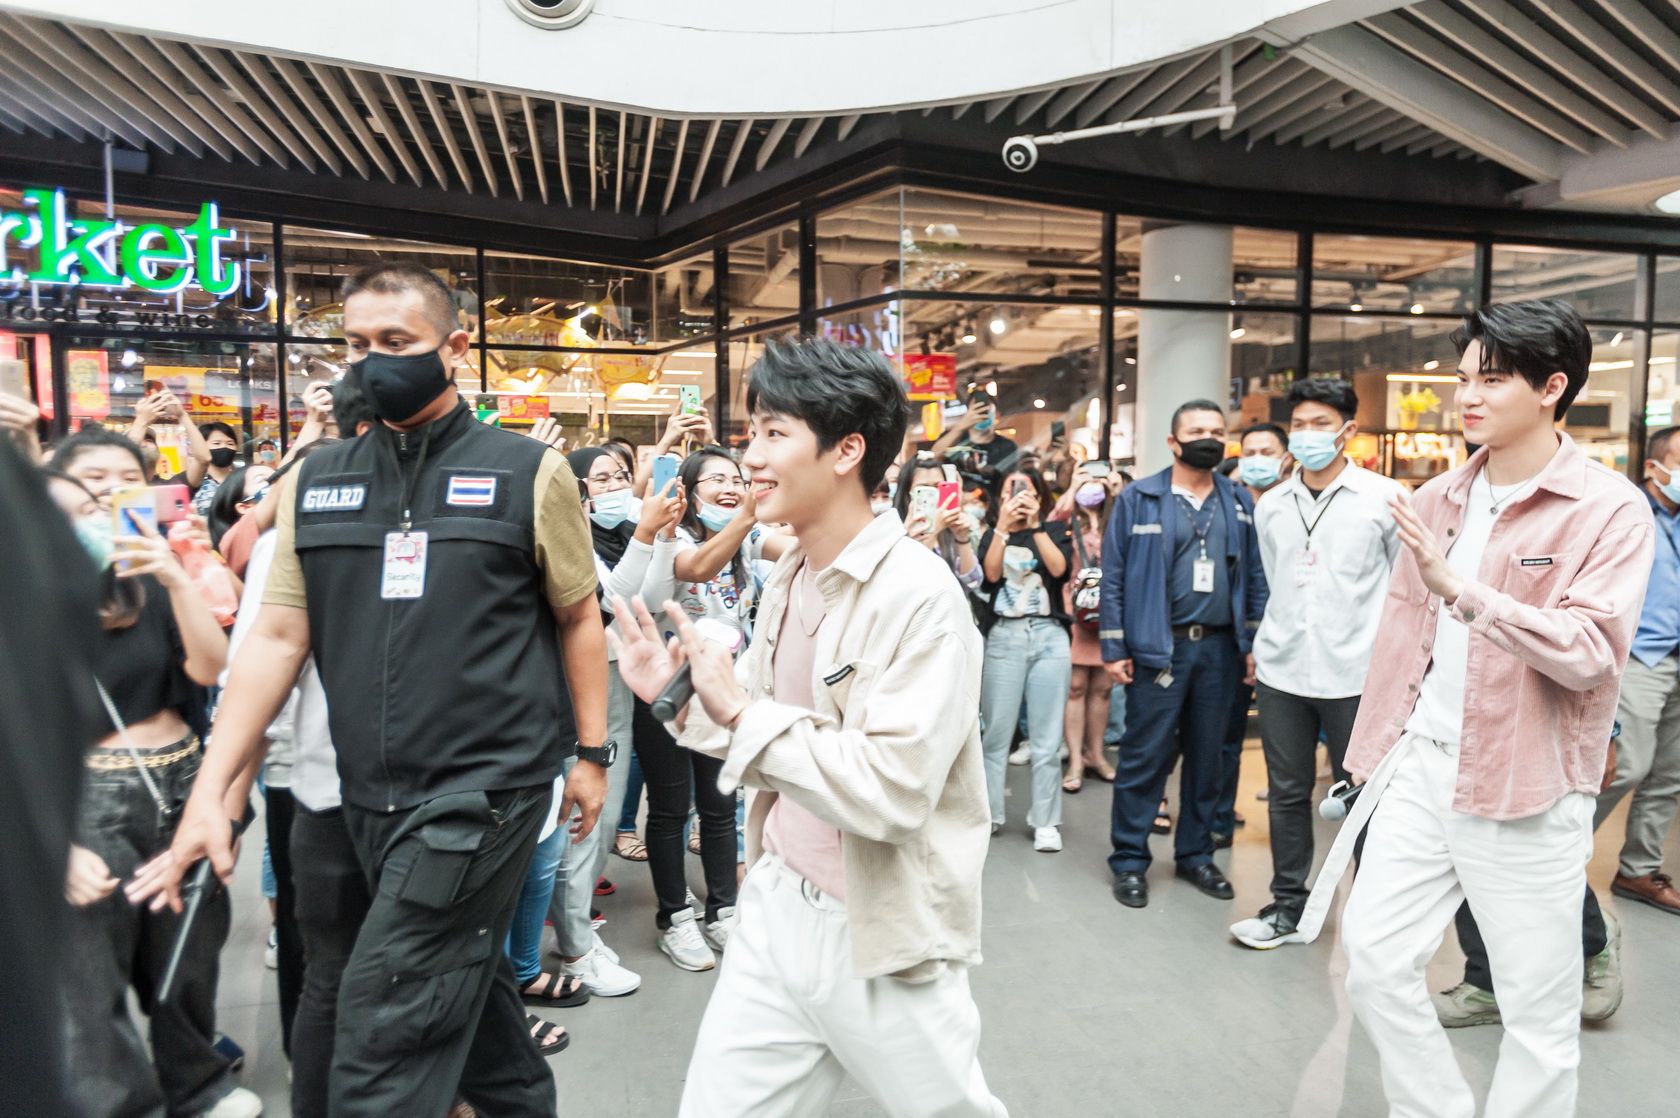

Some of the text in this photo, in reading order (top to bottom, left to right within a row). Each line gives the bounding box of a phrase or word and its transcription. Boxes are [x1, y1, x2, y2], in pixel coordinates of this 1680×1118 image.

[95, 306, 119, 324] &
[134, 311, 213, 328] wine
[302, 487, 365, 508] GUARD
